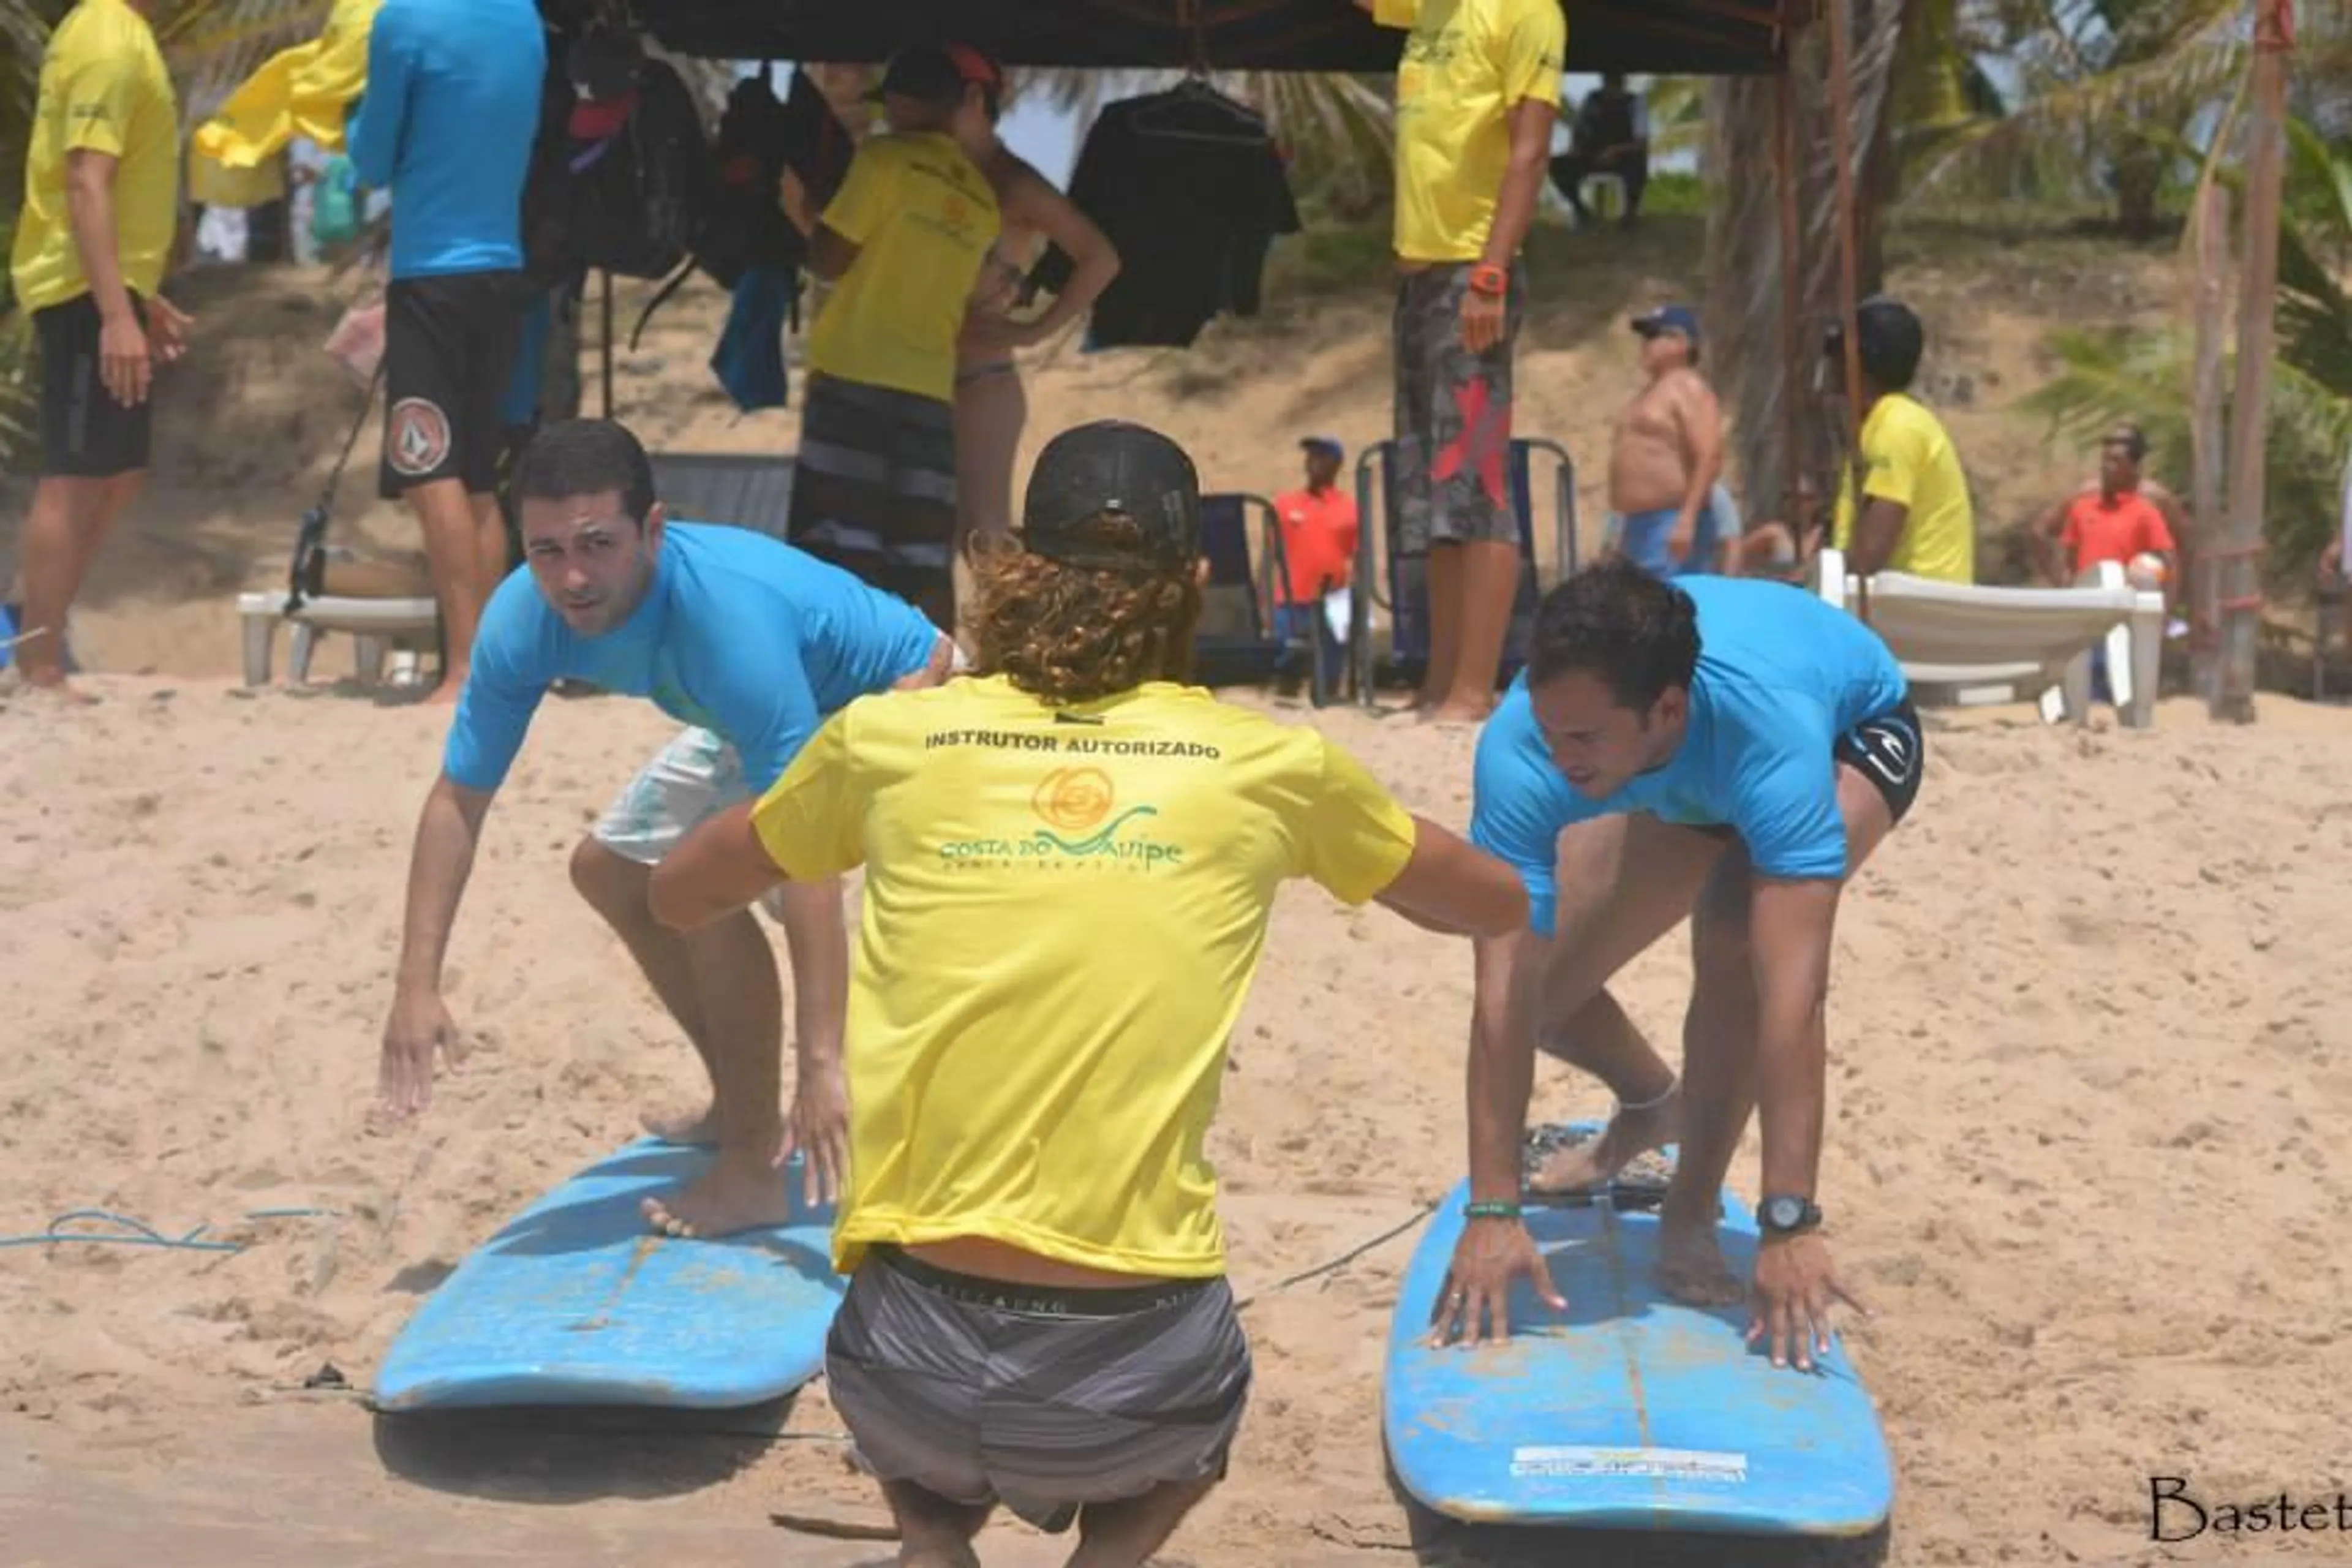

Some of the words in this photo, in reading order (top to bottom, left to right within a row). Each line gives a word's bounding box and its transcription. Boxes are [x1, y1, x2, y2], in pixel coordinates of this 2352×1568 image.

[925, 729, 1057, 751] INSTRUTOR
[1065, 739, 1221, 760] AUTORIZADO
[940, 840, 1013, 859] COSTA
[1019, 839, 1052, 856] DO
